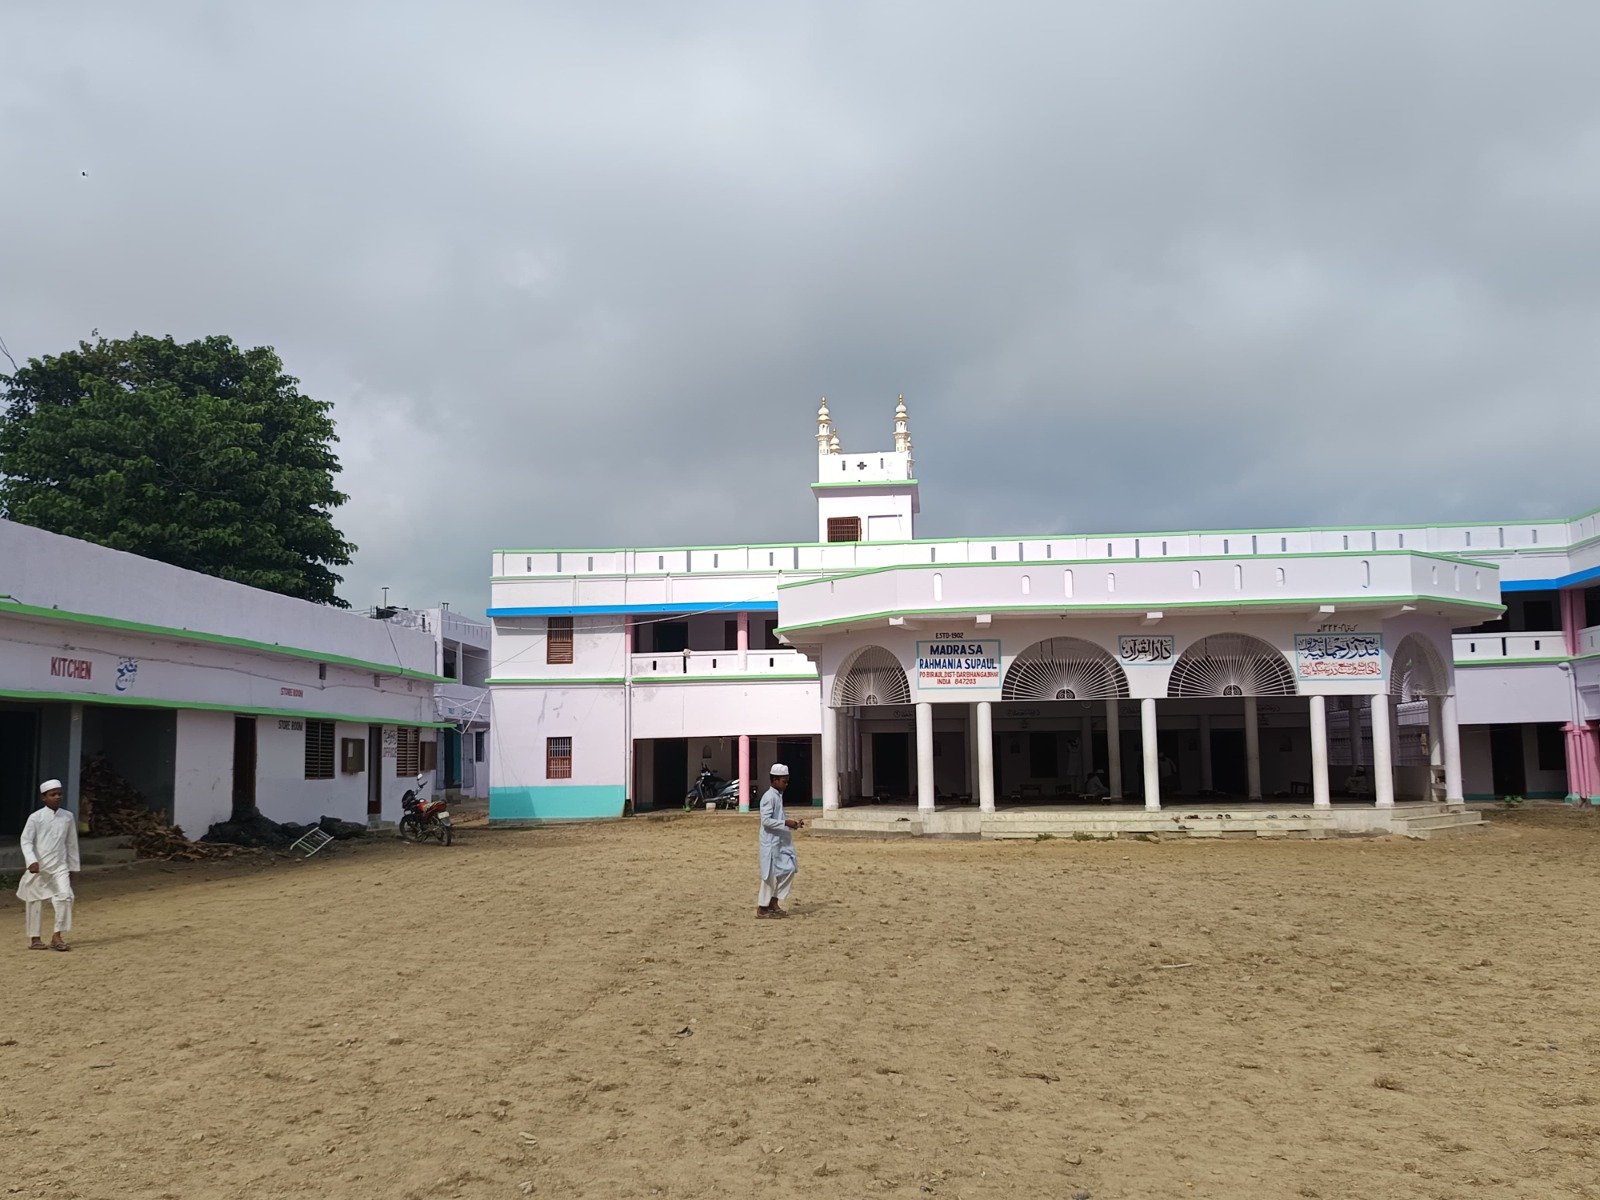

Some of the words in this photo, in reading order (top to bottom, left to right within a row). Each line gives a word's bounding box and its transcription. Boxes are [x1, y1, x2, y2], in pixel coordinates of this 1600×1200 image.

[930, 644, 983, 655] MADRASA
[50, 656, 92, 680] KITCHEN
[919, 658, 963, 670] RAHMANIA
[964, 658, 997, 670] SUPAUL
[280, 687, 293, 697] STORE
[292, 688, 304, 698] ROOM
[278, 719, 291, 730] STORE
[291, 720, 304, 731] ROOM
